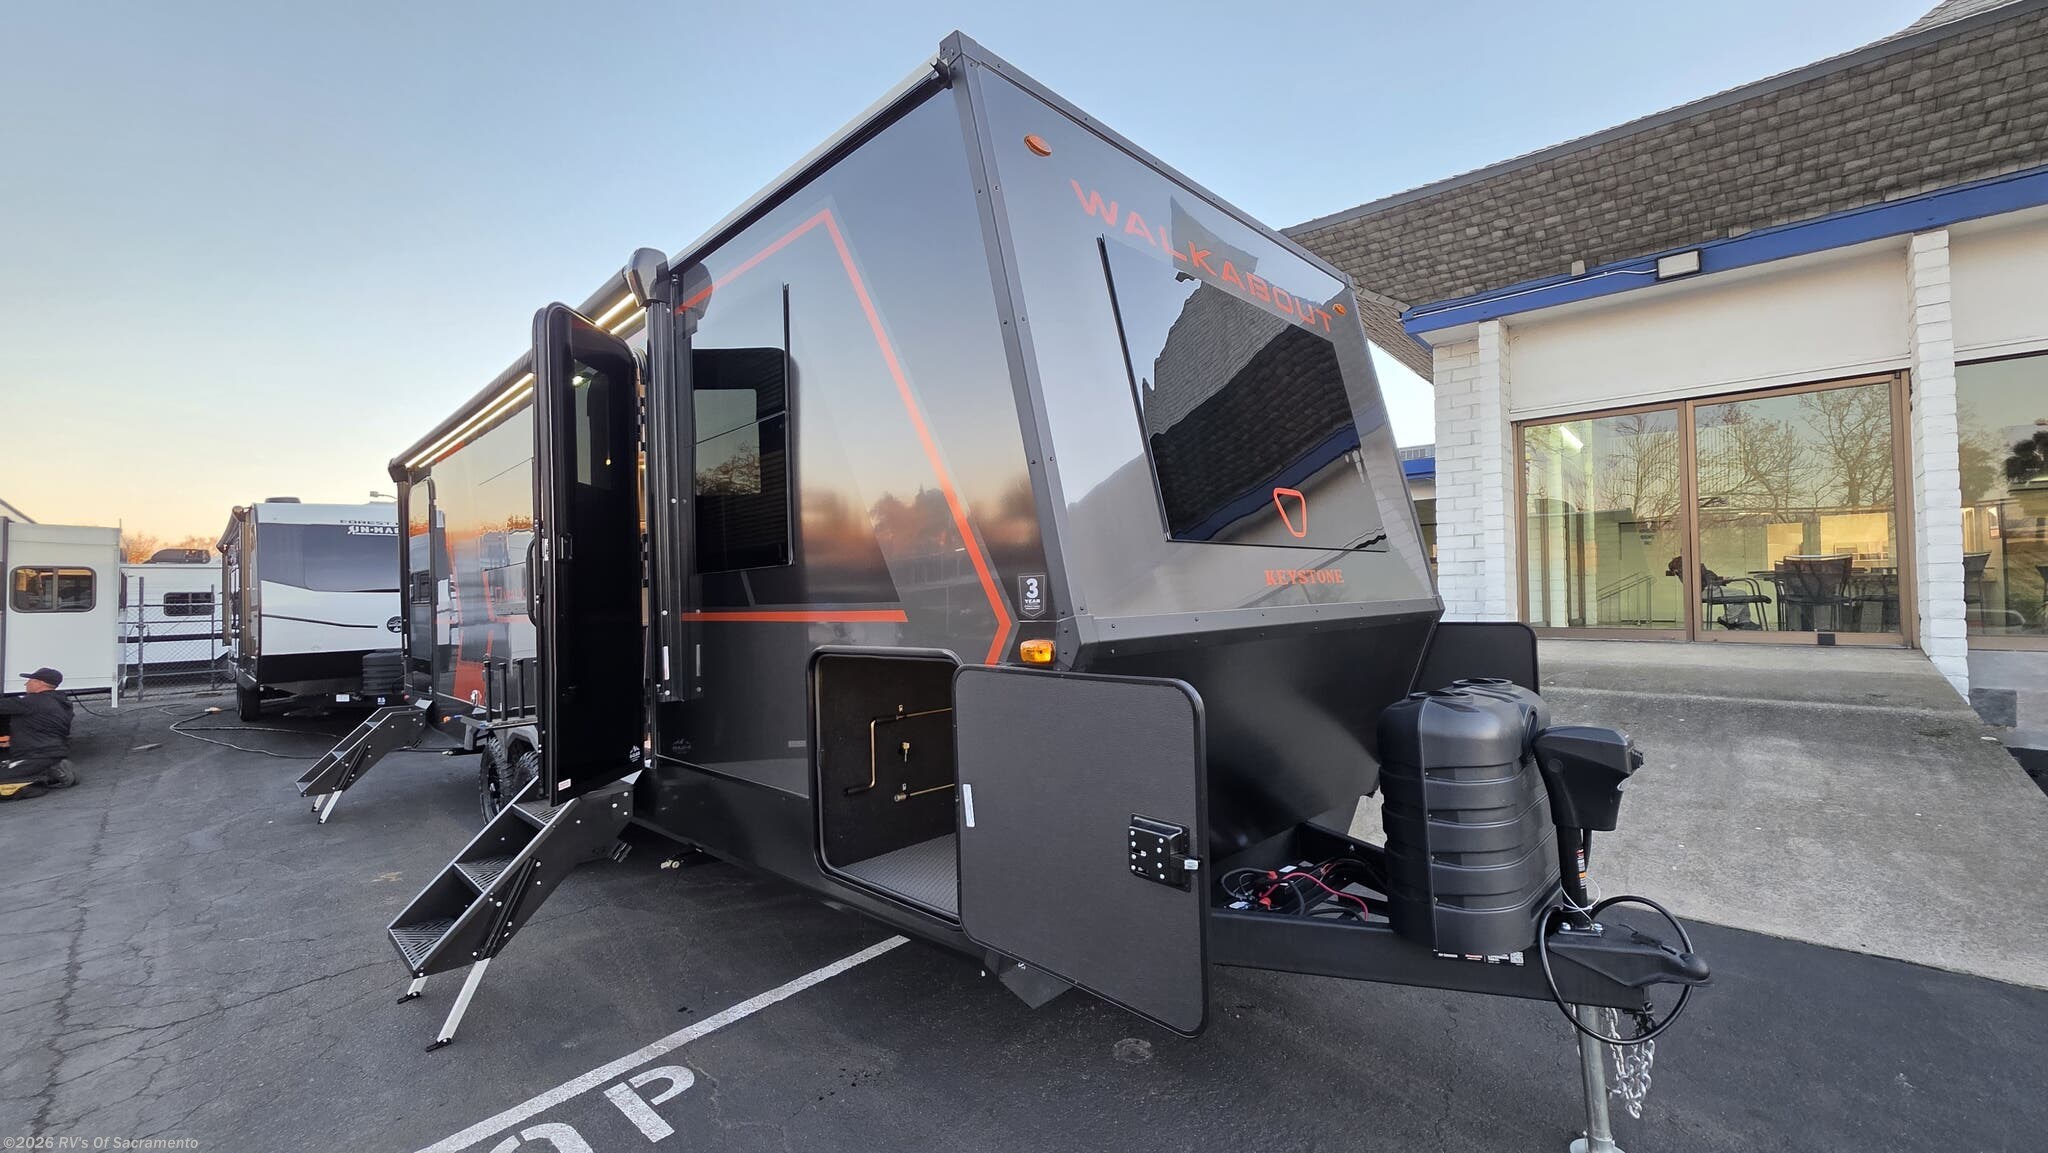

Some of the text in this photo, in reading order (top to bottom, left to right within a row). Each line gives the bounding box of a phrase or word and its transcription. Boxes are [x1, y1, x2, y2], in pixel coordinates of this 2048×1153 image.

[1070, 178, 1333, 333] WALKABOUT
[1264, 569, 1344, 585] KEYSTONE
[1026, 578, 1038, 598] 3
